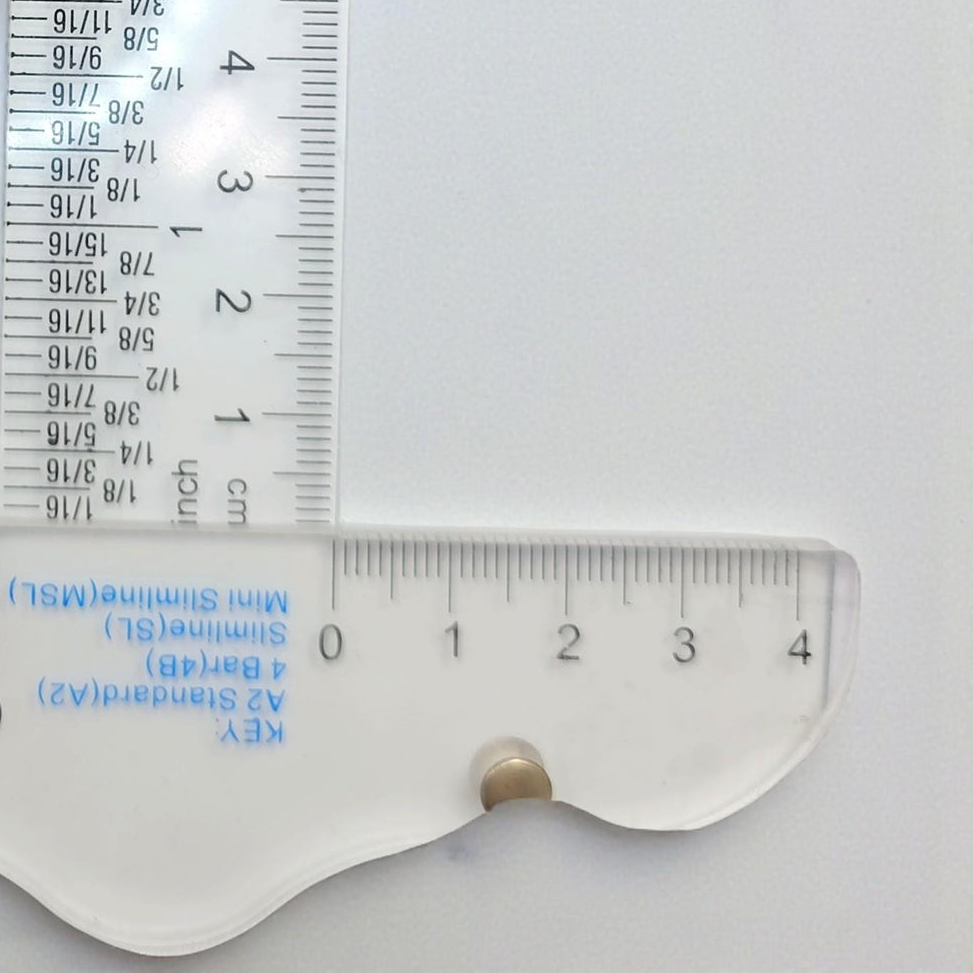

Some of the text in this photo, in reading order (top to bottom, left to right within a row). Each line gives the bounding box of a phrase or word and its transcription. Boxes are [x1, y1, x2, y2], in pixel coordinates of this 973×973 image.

[54, 9, 112, 34] 11/16
[124, 27, 159, 51] 5/8
[53, 46, 101, 69] 9/16
[220, 50, 255, 75] 4
[151, 67, 184, 90] 1/2
[52, 82, 100, 106] 7/16
[109, 101, 143, 125] 3/8
[51, 120, 100, 146] 5/16
[124, 140, 157, 164] 1/4
[51, 158, 100, 182] 3/16
[217, 170, 253, 193] 3
[107, 178, 140, 202] 1/8
[50, 195, 97, 219] 1/16
[49, 232, 107, 257] 15/16
[169, 227, 202, 237] 1
[120, 251, 155, 276] 7/8
[49, 270, 107, 294] 13/16
[124, 292, 160, 316] 3/4
[216, 289, 251, 312] 2
[49, 308, 106, 333] 11/16
[119, 327, 154, 351] 5/8
[48, 345, 97, 370] 9/16
[146, 367, 179, 392] 1/2
[48, 383, 96, 407] 7/16
[104, 401, 140, 426] 3/8
[214, 408, 250, 423] 1
[47, 422, 96, 446] 5/16
[121, 441, 153, 466] 1/4
[47, 459, 95, 483] 3/16
[103, 479, 136, 503] 1/8
[171, 459, 198, 524] inch
[227, 479, 247, 524] cm
[46, 496, 92, 520] 1/16
[8, 577, 288, 613] Mini Slimline(MSL)
[105, 613, 287, 645] Slimline(SL)
[318, 623, 342, 660] 0
[445, 621, 458, 657] 1
[556, 623, 581, 661] 2
[672, 626, 696, 663] 3
[787, 629, 811, 665] 4
[146, 649, 287, 680] 4 Bar(4B)
[37, 677, 285, 712] A2 Standard(A2)
[215, 718, 283, 744] KEY:
